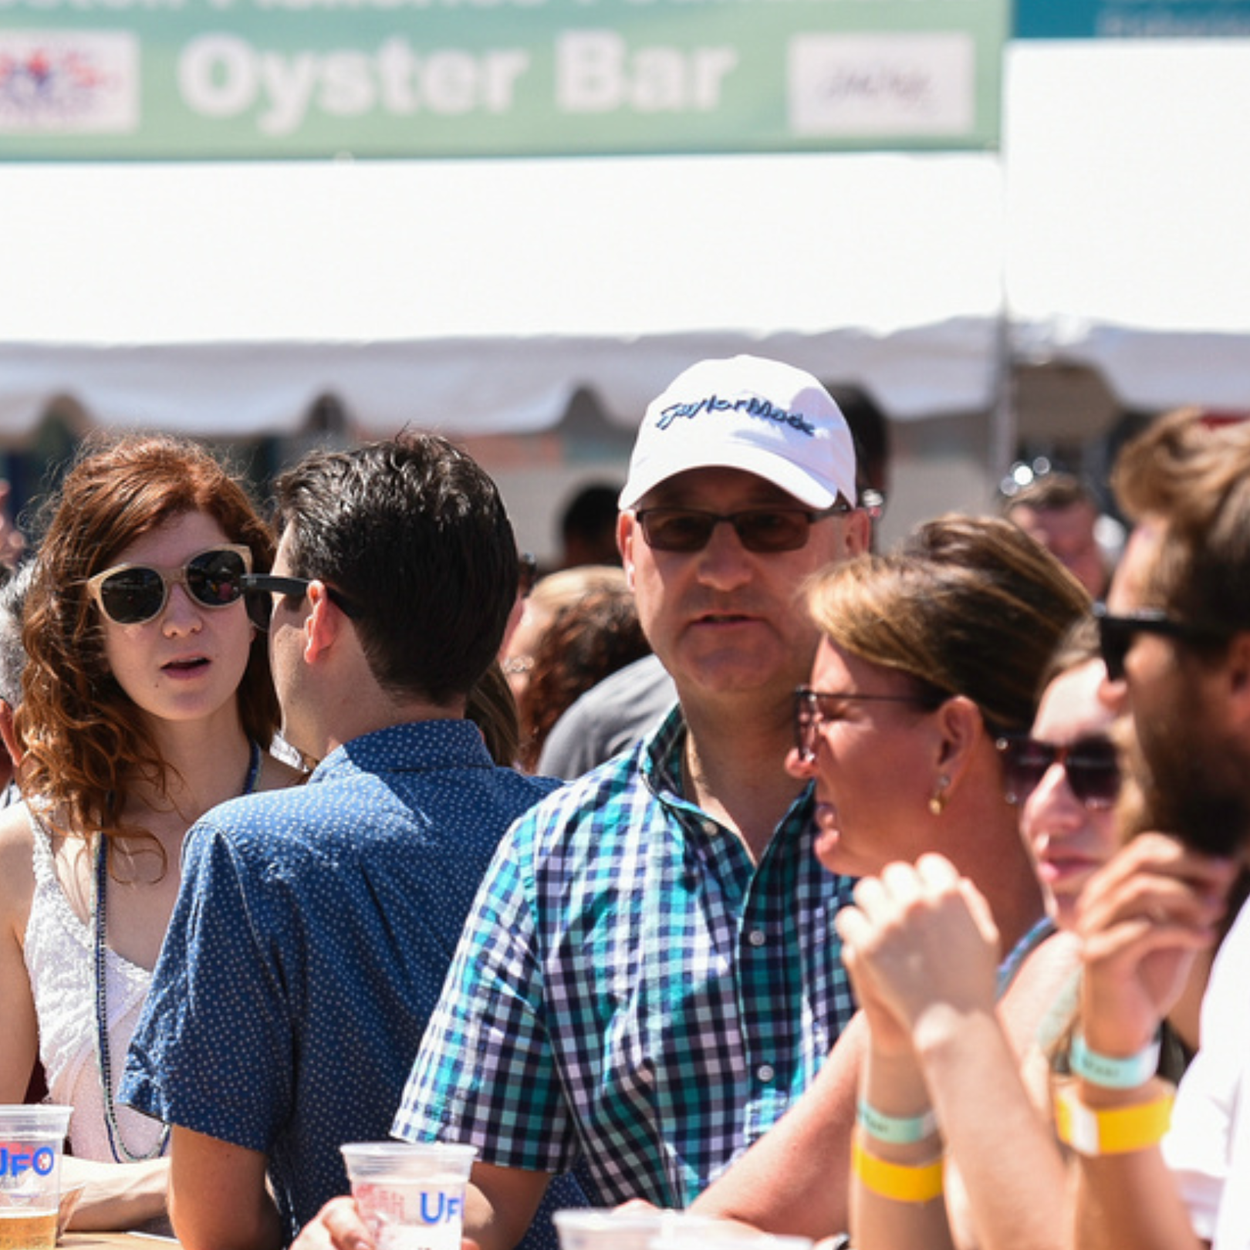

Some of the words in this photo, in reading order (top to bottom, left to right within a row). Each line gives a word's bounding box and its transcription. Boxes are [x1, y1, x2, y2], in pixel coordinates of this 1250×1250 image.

[178, 32, 529, 136] Oyster
[557, 30, 737, 112] Bar
[656, 395, 816, 437] TaylorMade
[421, 1192, 466, 1225] UF
